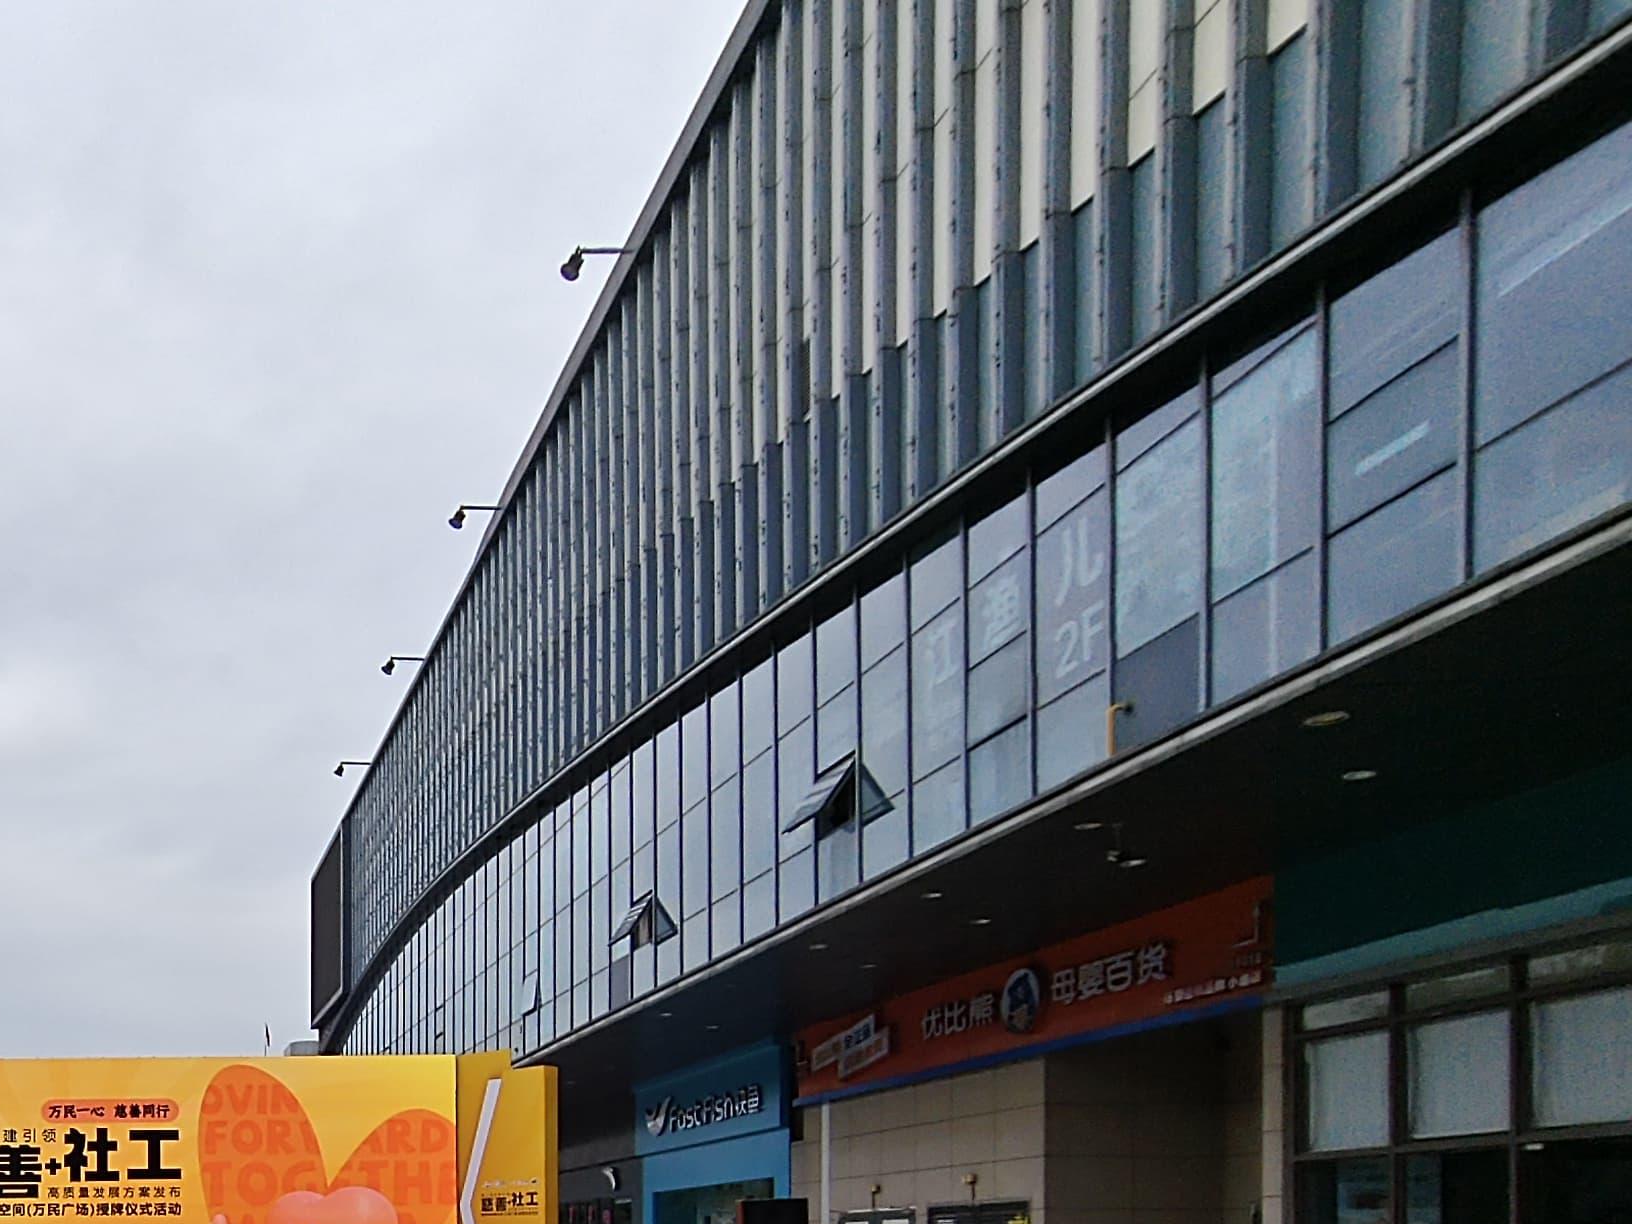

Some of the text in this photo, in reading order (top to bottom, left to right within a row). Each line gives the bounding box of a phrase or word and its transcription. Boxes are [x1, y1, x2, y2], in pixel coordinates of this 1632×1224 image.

[1055, 600, 1105, 680] 2F
[920, 993, 995, 1040] 优比熊
[1051, 943, 1169, 1006] 母婴百货
[48, 1103, 171, 1119] 万民一心 慈善同行
[47, 1186, 182, 1199] 高质量发展方案发布
